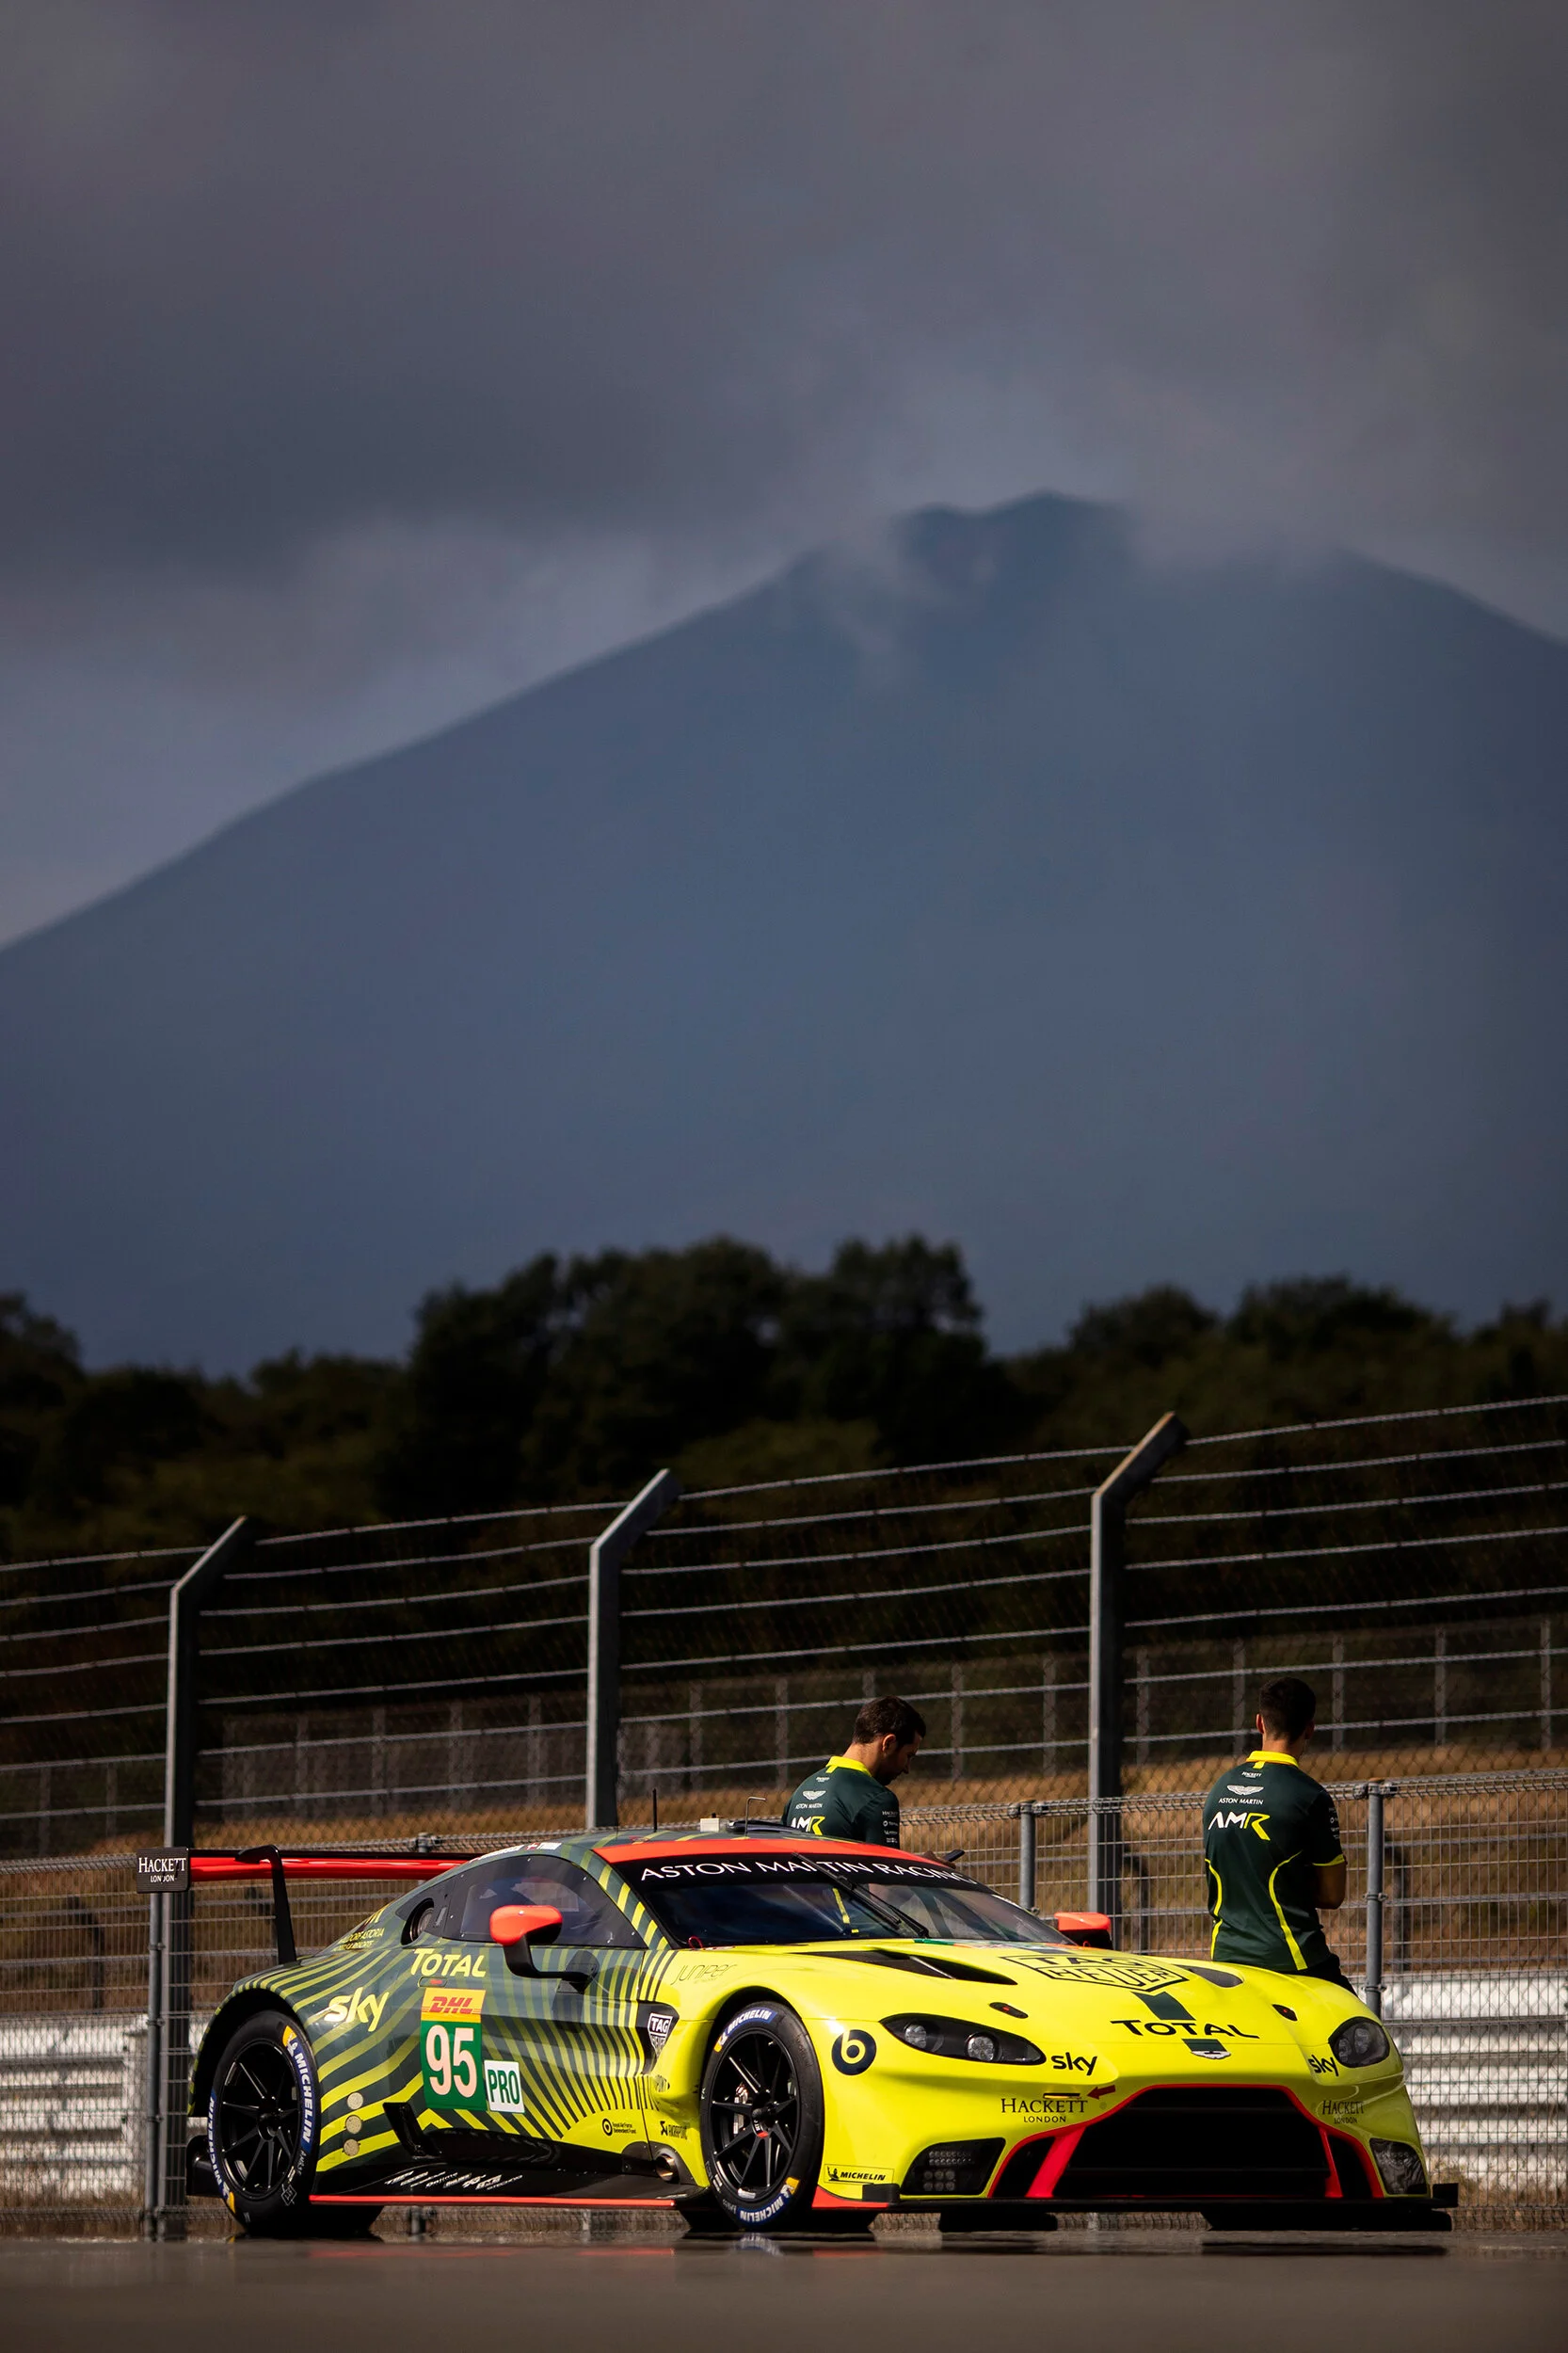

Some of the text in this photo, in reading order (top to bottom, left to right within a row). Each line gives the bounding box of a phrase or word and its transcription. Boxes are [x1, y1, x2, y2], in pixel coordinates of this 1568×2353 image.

[1208, 1811, 1271, 1841] AMR
[641, 1862, 753, 1881] ASTON
[872, 1863, 978, 1883] RACING
[410, 1948, 487, 1977] TOTAL
[1019, 1957, 1136, 1966] TAG
[1048, 1966, 1174, 1987] HEUER
[324, 1987, 390, 2032] sky
[429, 1996, 473, 2014] DHL
[651, 2018, 670, 2033] TAG
[728, 2009, 772, 2034] MICHELIN
[1110, 2019, 1260, 2040] TOTAL
[425, 2025, 477, 2098] 95
[1051, 2052, 1097, 2076] sky
[1308, 2054, 1339, 2076] sky
[488, 2069, 520, 2105] PRO
[294, 2053, 313, 2145] MICHELIN
[1000, 2098, 1088, 2113] HACKETT
[1322, 2100, 1364, 2115] HACKETT
[840, 2171, 886, 2181] MICHELIN
[740, 2198, 784, 2223] MICHELIN
